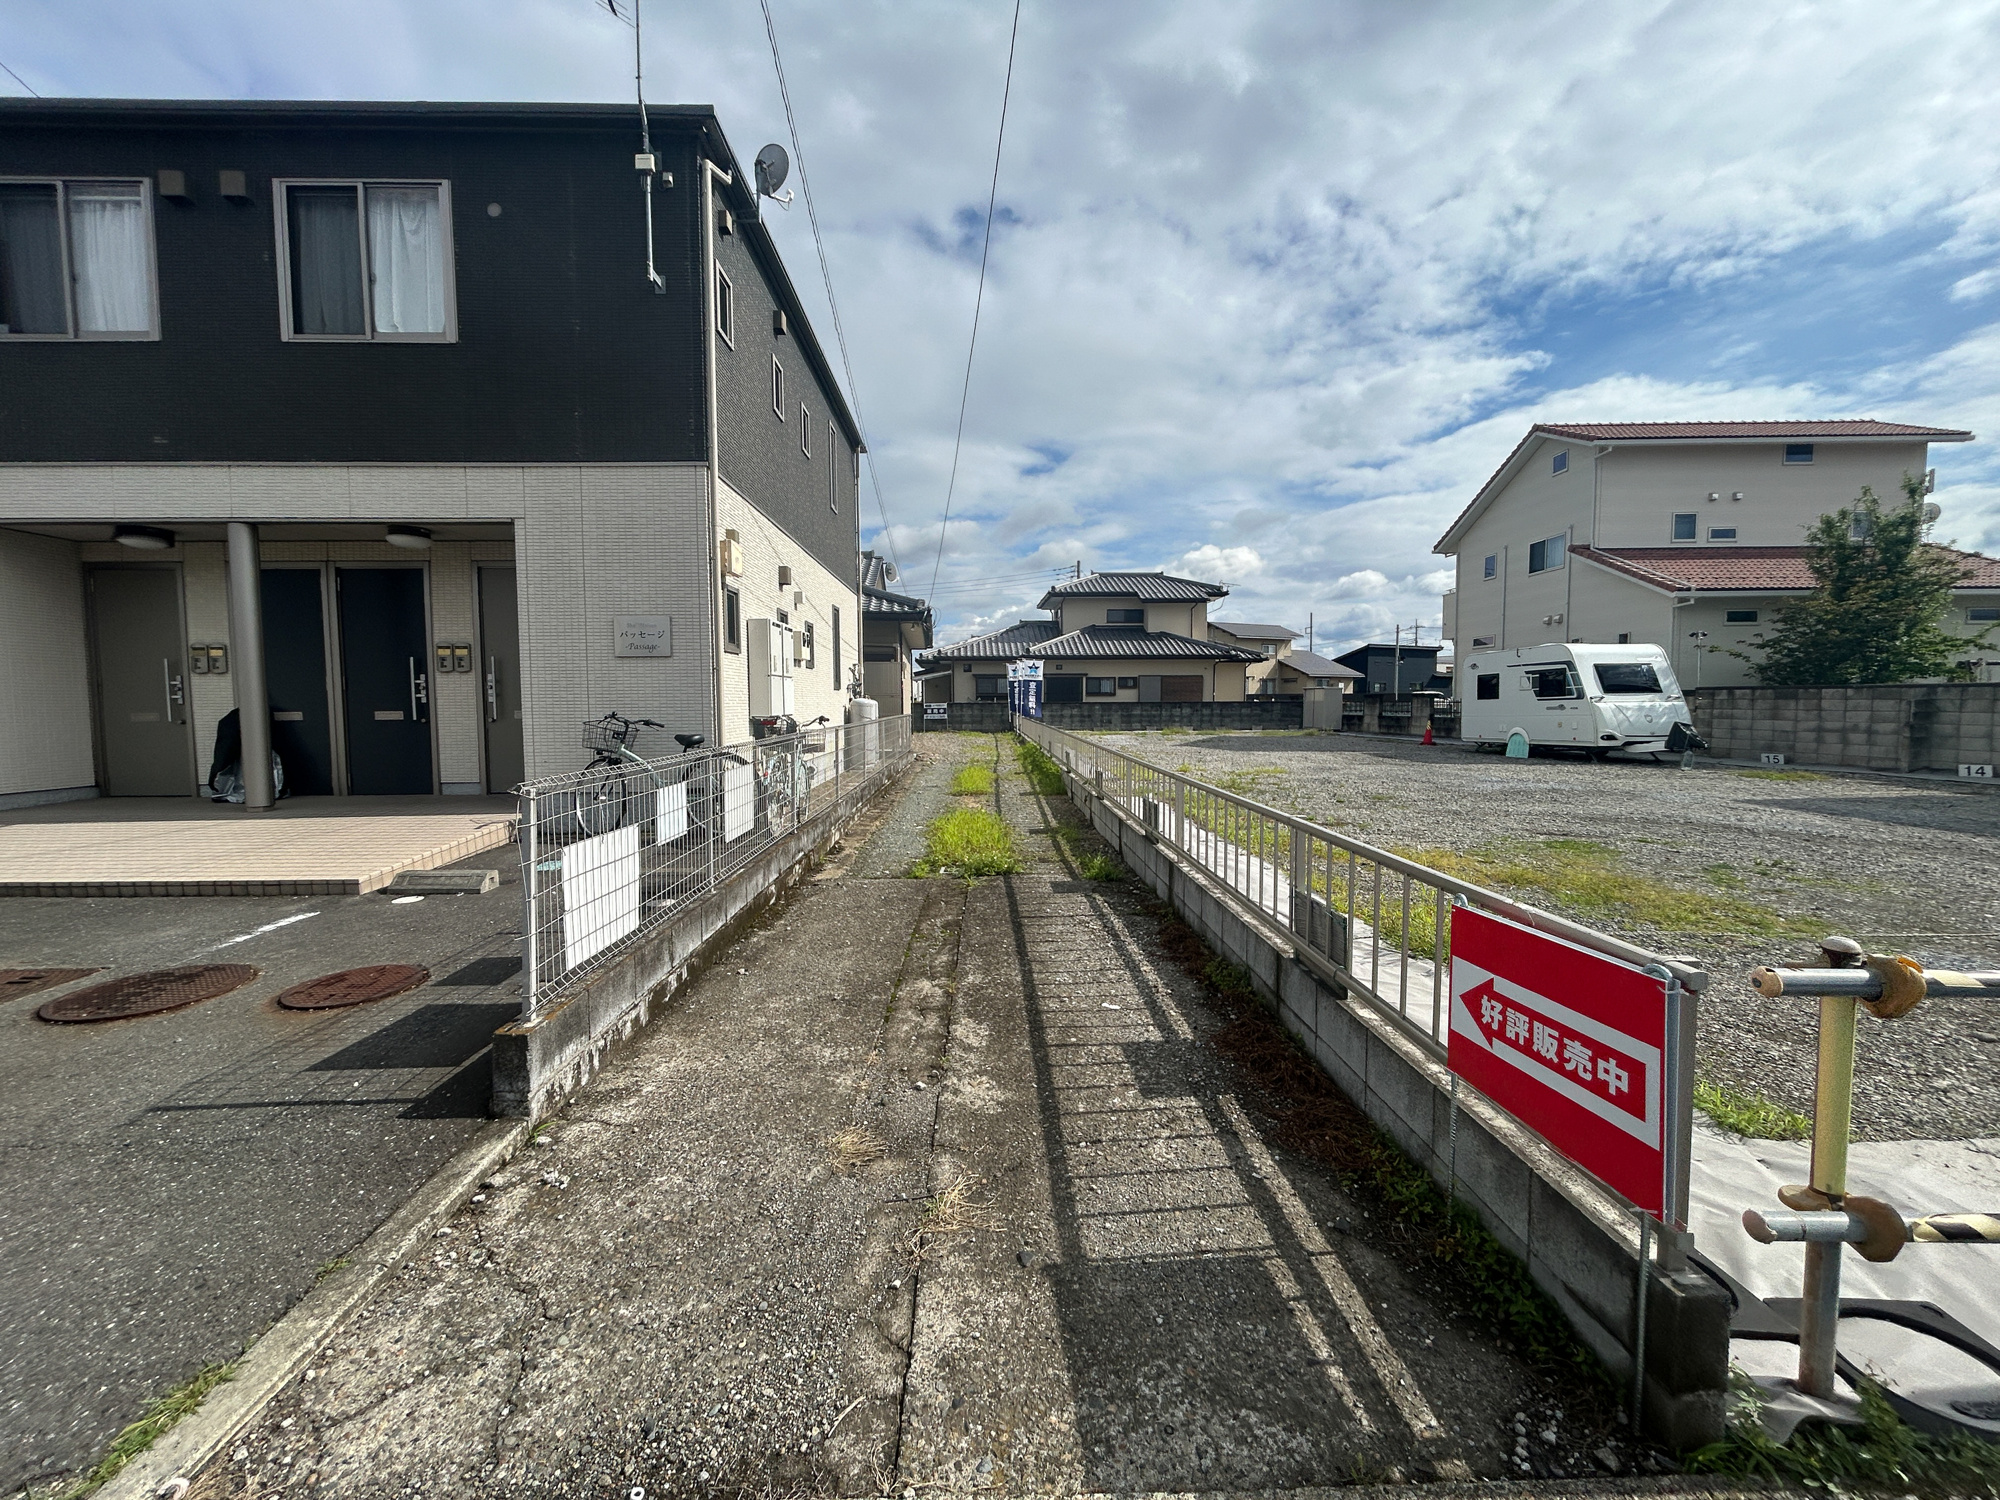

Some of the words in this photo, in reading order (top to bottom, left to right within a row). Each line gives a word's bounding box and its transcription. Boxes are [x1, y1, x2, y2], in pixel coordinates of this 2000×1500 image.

[619, 630, 665, 639] パッセージ
[1764, 754, 1780, 764] 15
[1964, 765, 1986, 777] 14
[1480, 994, 1629, 1096] 好評販売中
